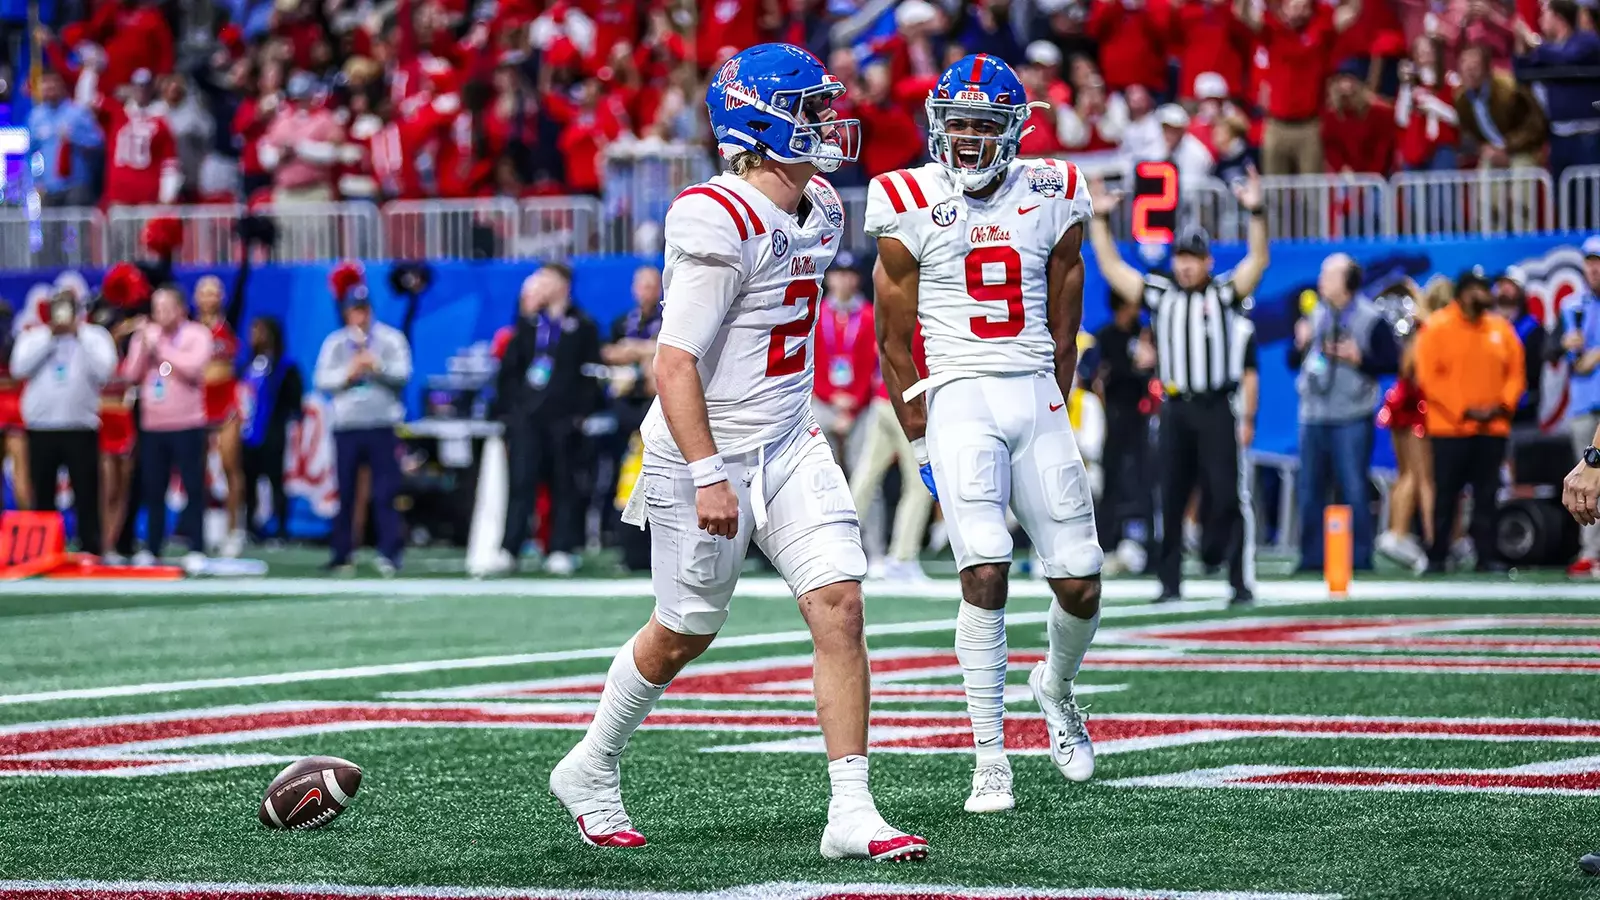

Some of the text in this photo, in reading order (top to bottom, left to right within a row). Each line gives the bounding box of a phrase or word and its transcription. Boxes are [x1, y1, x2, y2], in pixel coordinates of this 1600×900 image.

[961, 92, 984, 101] REBS
[1028, 178, 1064, 189] PEACH
[933, 203, 957, 226] SEC
[1131, 161, 1179, 245] 2
[772, 230, 788, 256] SEC
[964, 245, 1026, 339] 9
[765, 278, 820, 377] 2
[5, 525, 47, 567] 10
